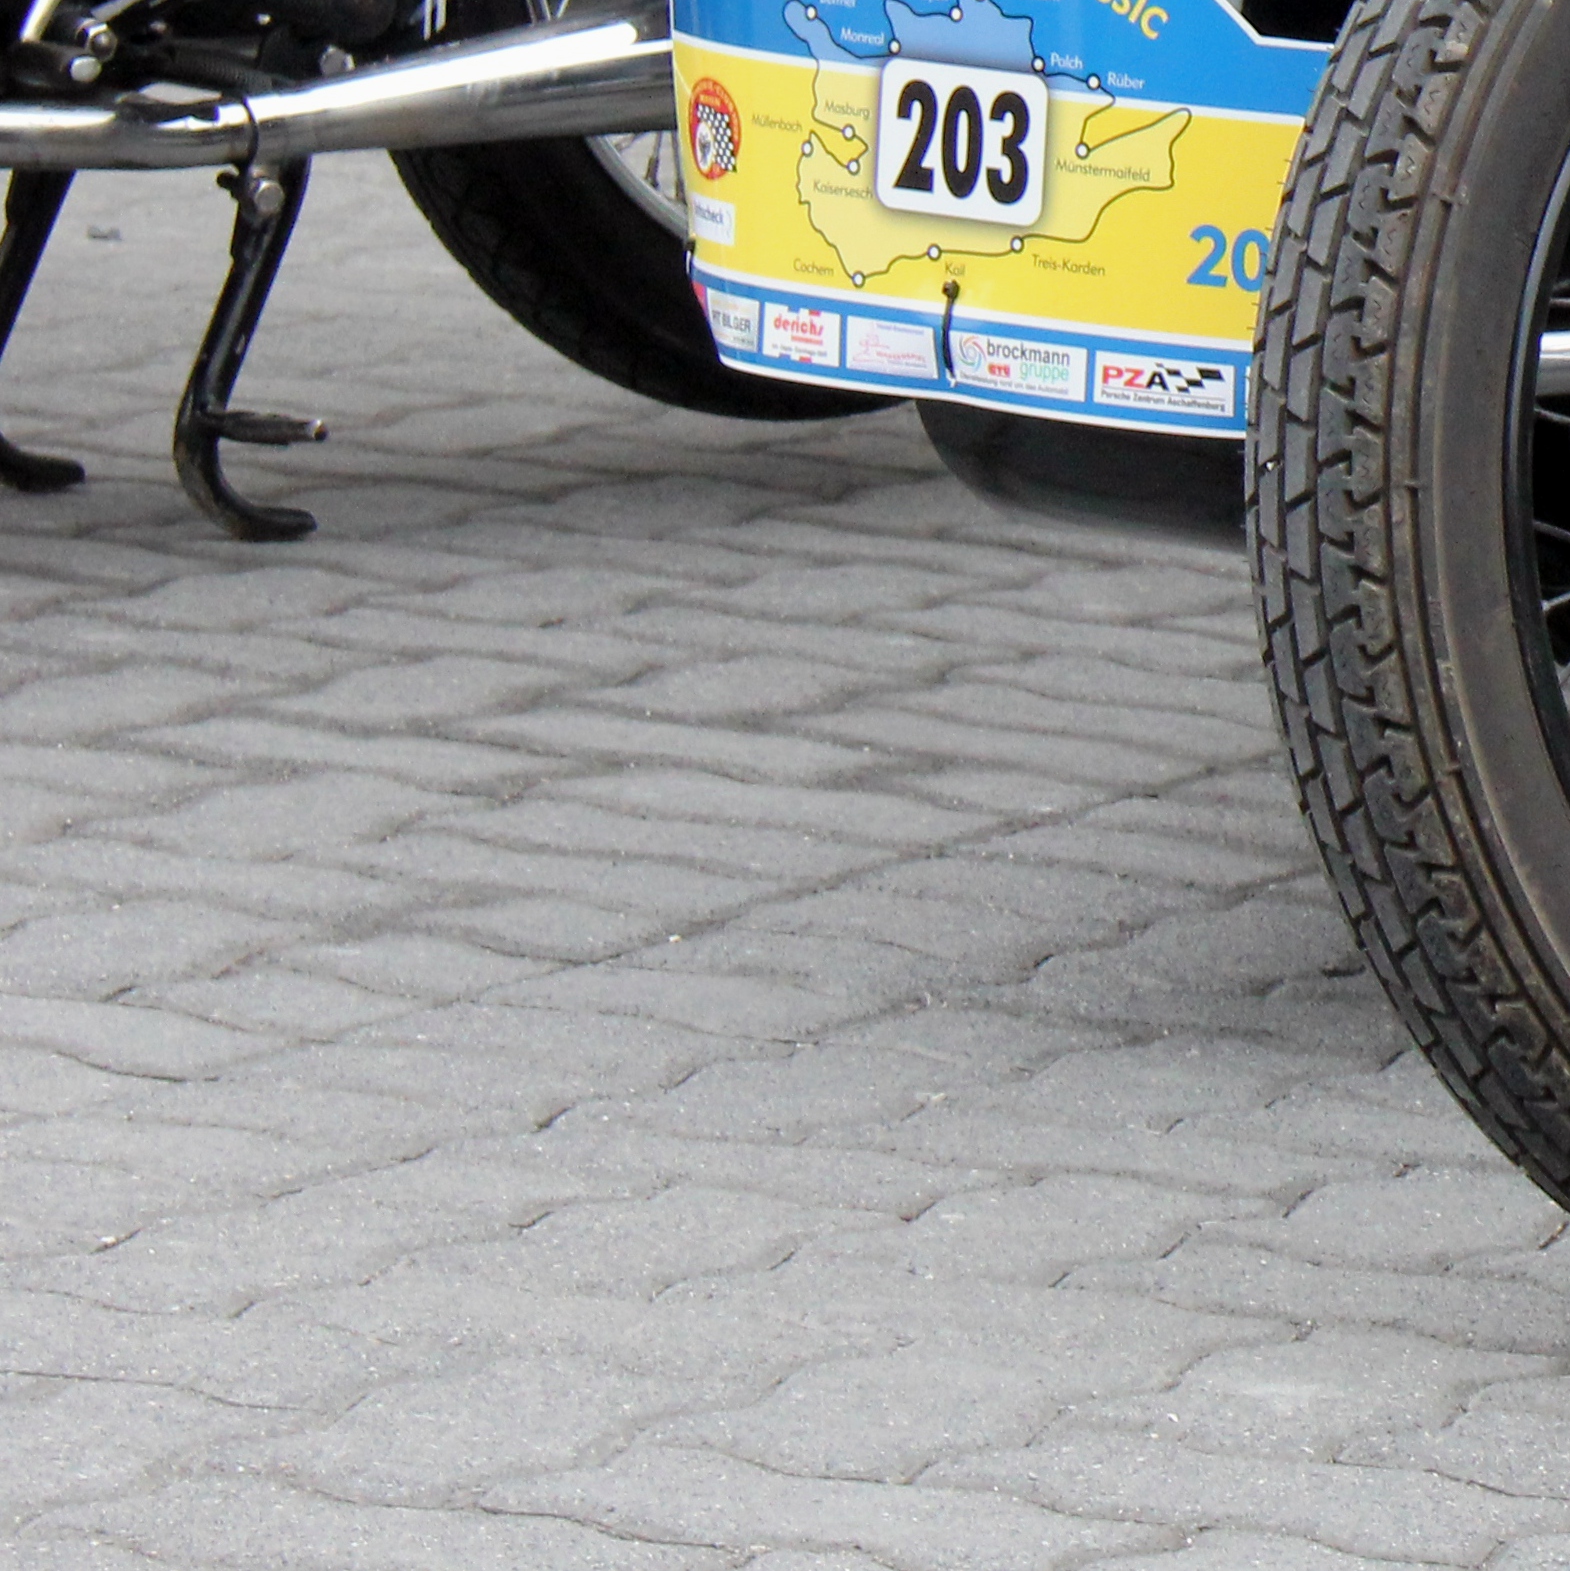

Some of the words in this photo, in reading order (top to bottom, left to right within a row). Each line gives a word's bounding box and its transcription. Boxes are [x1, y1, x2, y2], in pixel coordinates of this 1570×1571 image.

[840, 27, 885, 46] Monreal
[1107, 72, 1146, 90] Rüber
[824, 100, 870, 120] Masburg
[751, 114, 803, 133] Müllenbach
[892, 80, 1030, 205] 203
[1055, 158, 1150, 182] Münstermaifeld
[813, 180, 873, 200] Kaisersesch
[793, 258, 834, 277] Cochem
[1032, 254, 1106, 277] Treis-Karden
[773, 314, 824, 336] derichs
[986, 339, 1070, 366] brockmann
[1019, 360, 1070, 382] gruppe
[1102, 364, 1170, 391] PZA
[1101, 388, 1130, 402] Porsche
[1132, 392, 1165, 405] Zentrum
